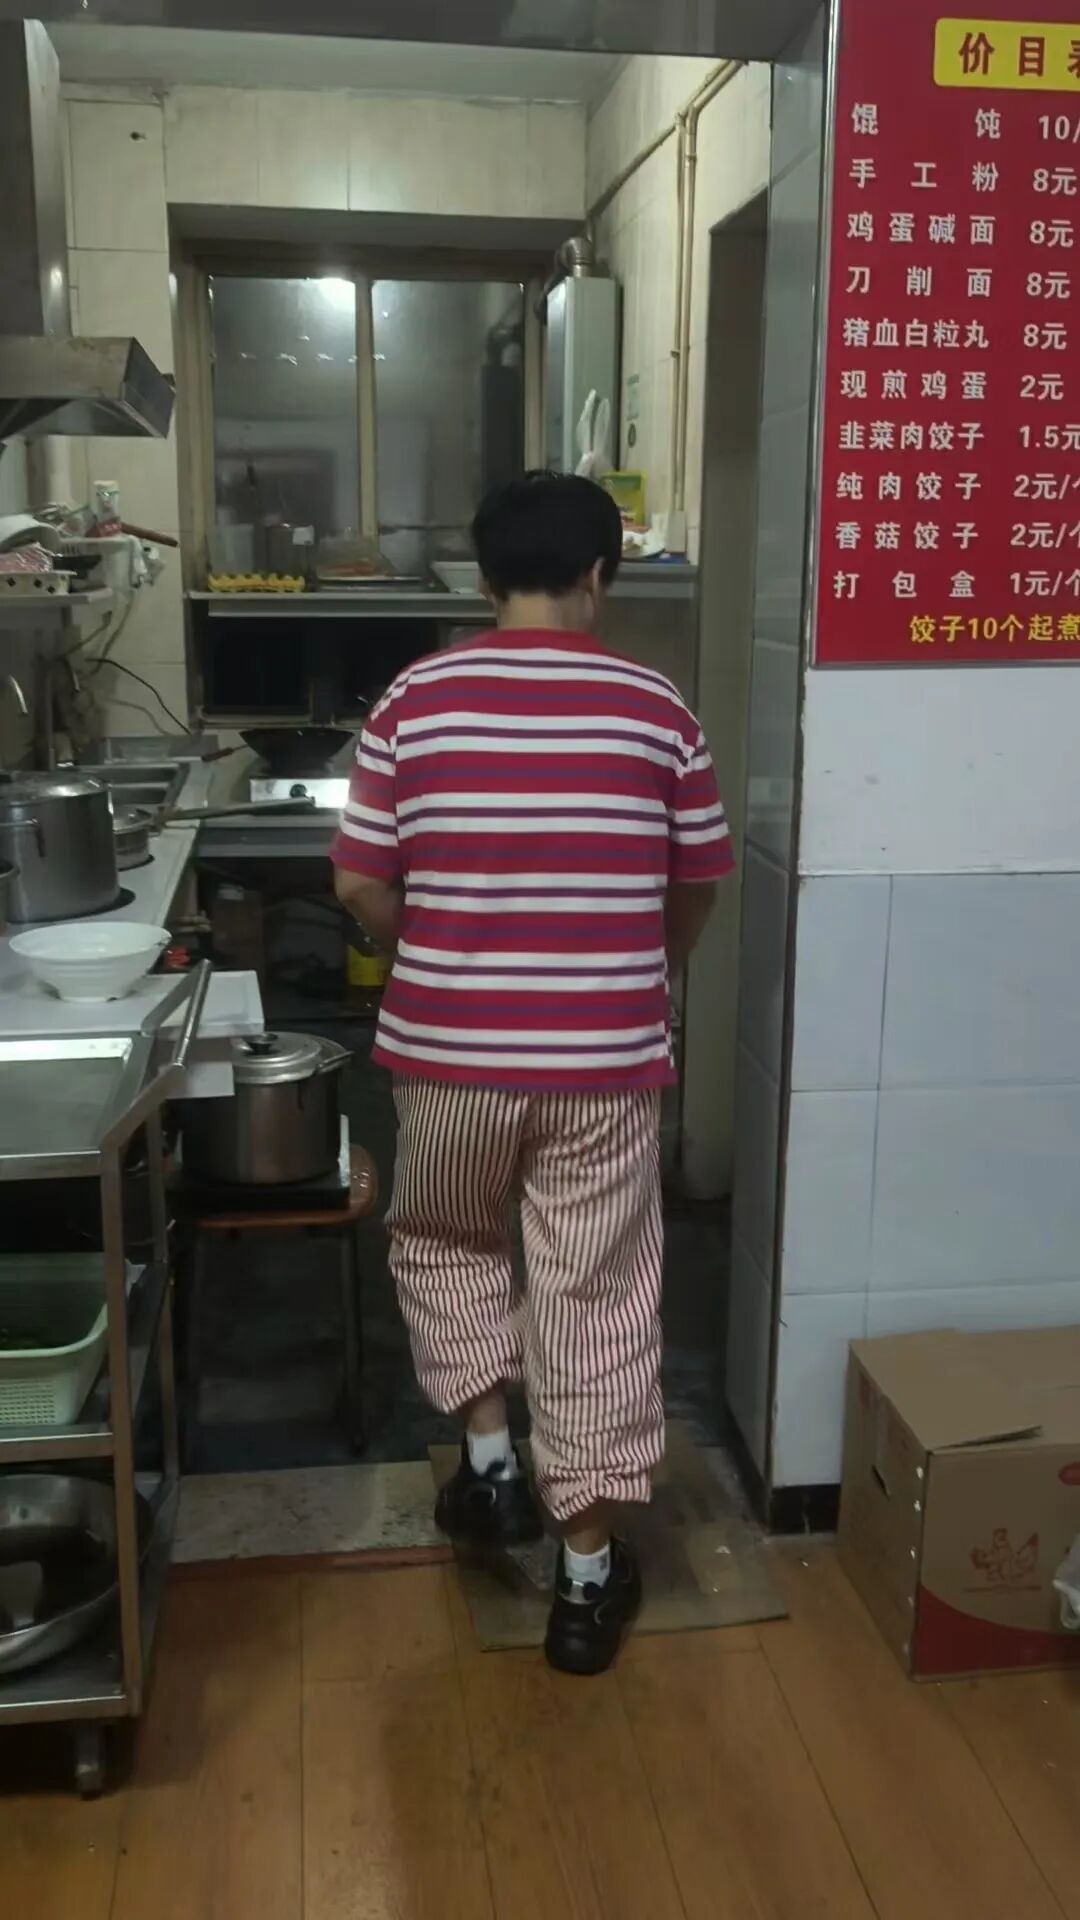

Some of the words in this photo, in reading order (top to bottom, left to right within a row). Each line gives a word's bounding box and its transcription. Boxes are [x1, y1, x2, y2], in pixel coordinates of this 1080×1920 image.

[851, 102, 1001, 139] 馄饨
[848, 158, 999, 192] 手工粉
[1032, 167, 1077, 196] 8元
[846, 210, 996, 245] 鸡蛋碱面
[1029, 219, 1074, 248] 8元
[845, 265, 993, 297] 刀削面
[1026, 271, 1071, 299] 8元
[842, 316, 990, 349] 猪血白粒丸
[1023, 322, 1067, 350] 8元
[840, 369, 987, 400] 现煎鸡蛋
[1019, 373, 1064, 401] 2元
[838, 420, 985, 451] 韭菜肉饺子
[835, 471, 982, 501] 纯肉饺子
[1013, 473, 1080, 500] 2元/
[835, 521, 979, 550] 香菇饺子
[833, 570, 975, 599] 打包盒
[909, 613, 1080, 643] 饺子10个起煮
